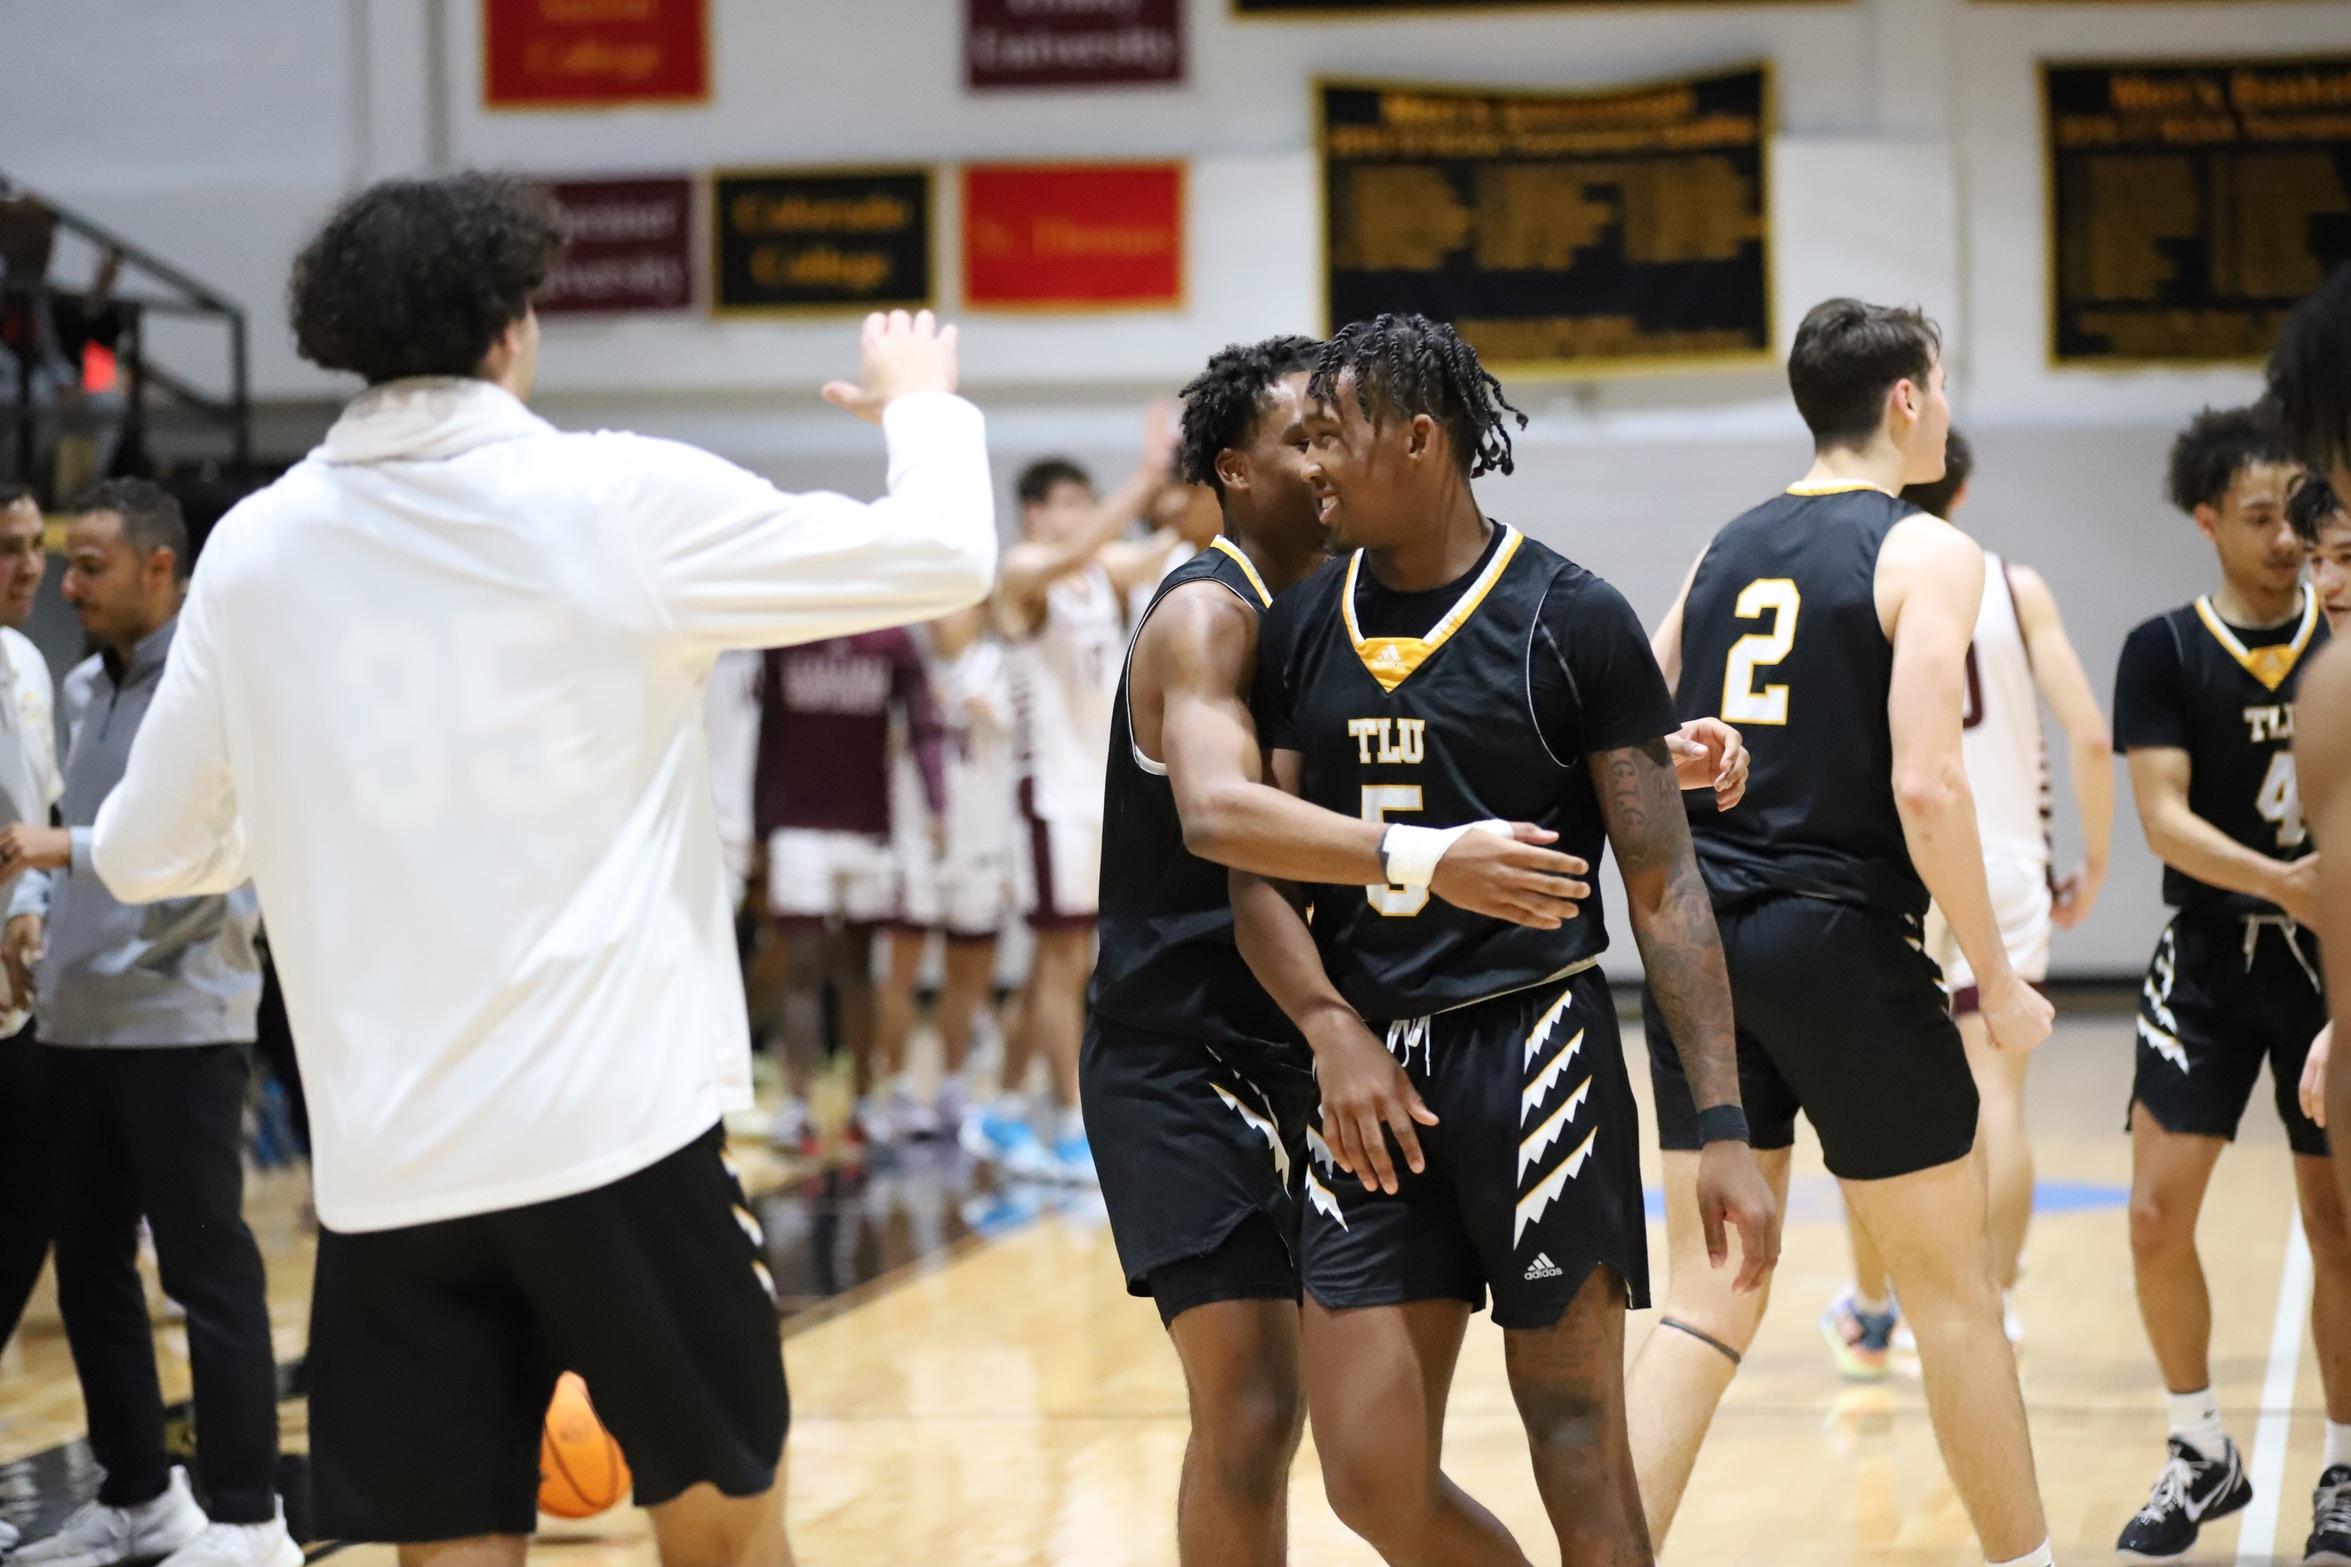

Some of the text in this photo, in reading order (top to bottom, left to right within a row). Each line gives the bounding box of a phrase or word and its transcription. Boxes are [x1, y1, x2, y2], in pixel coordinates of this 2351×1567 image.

[1720, 578, 1801, 726] 2
[1348, 717, 1425, 764] TLU
[2256, 751, 2307, 846] 4
[1523, 1267, 1563, 1280] adidas
